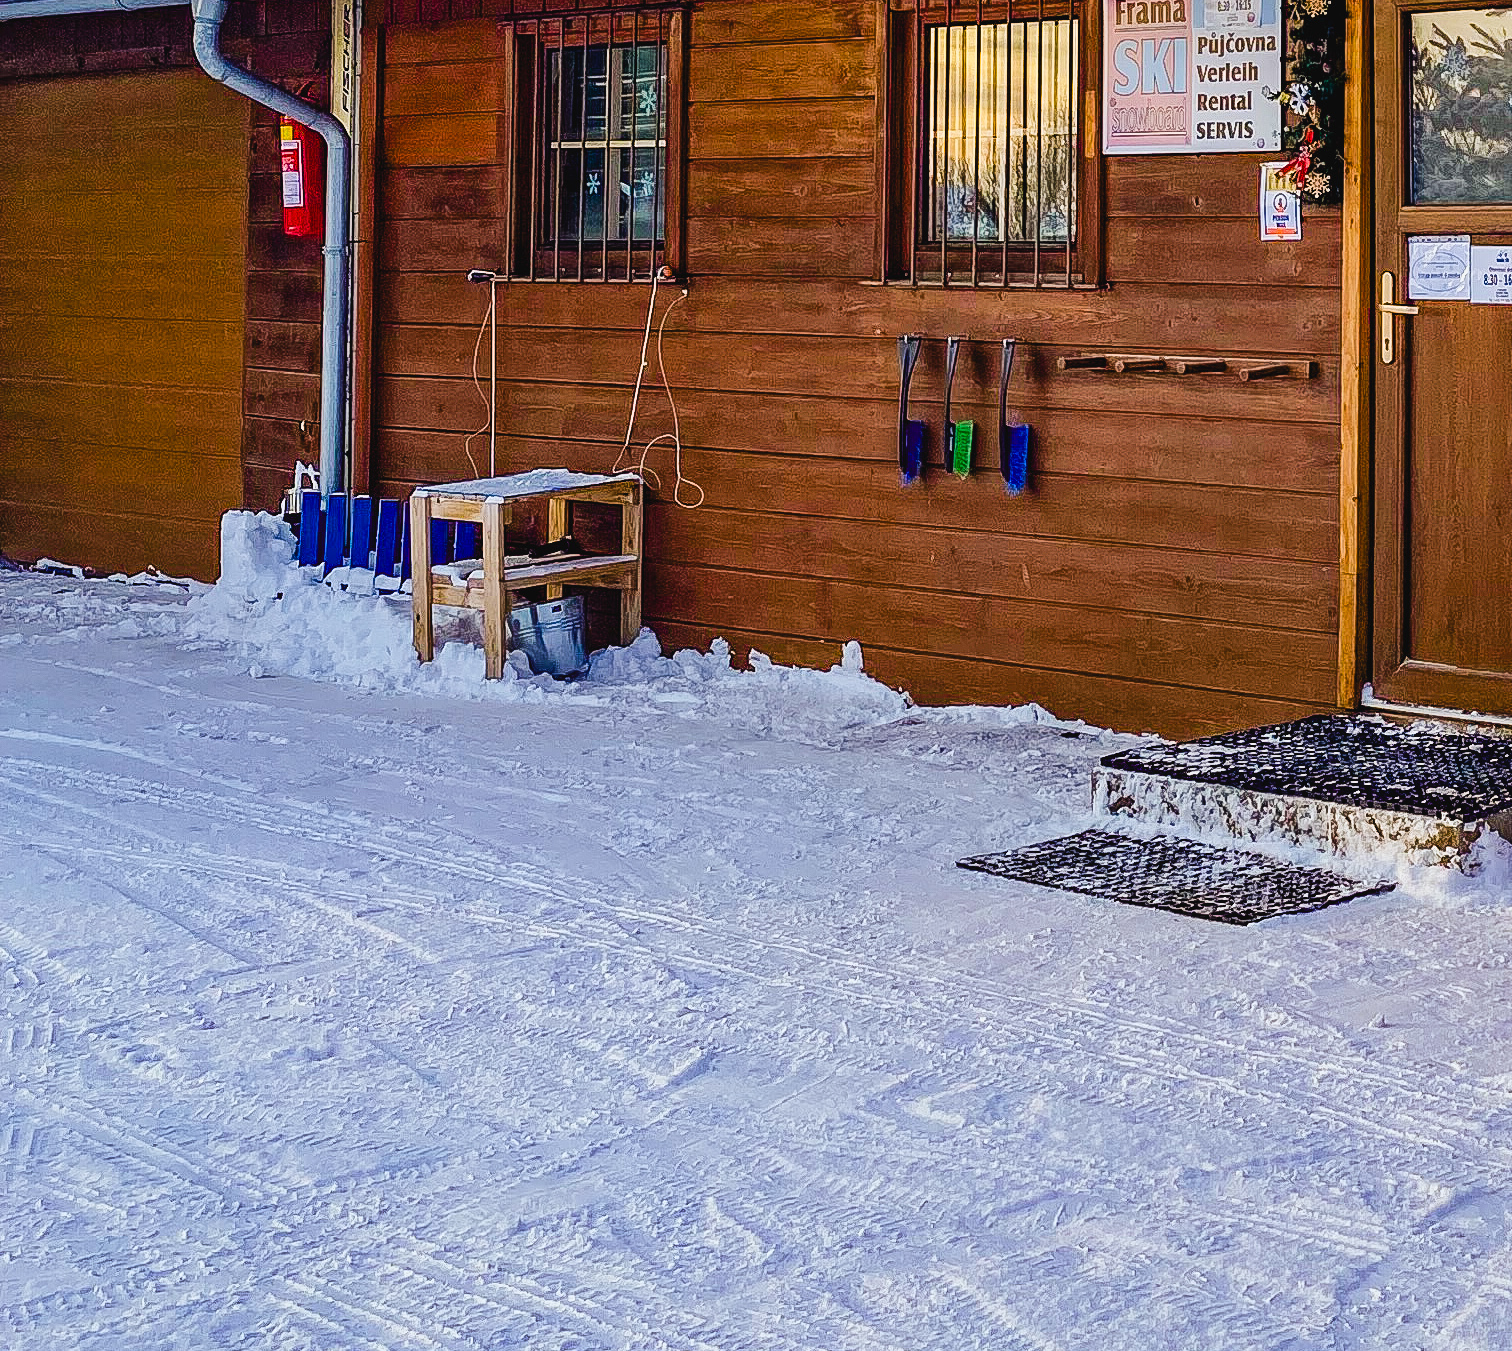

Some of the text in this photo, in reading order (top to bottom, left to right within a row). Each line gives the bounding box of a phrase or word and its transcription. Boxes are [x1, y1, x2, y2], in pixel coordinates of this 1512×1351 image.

[1197, 32, 1277, 57] Půjčovna
[1113, 36, 1188, 97] SKI
[1196, 62, 1259, 82] Verleih
[1197, 91, 1253, 111] Rental
[1112, 97, 1187, 132] snowboard
[1196, 121, 1254, 140] SERVIS
